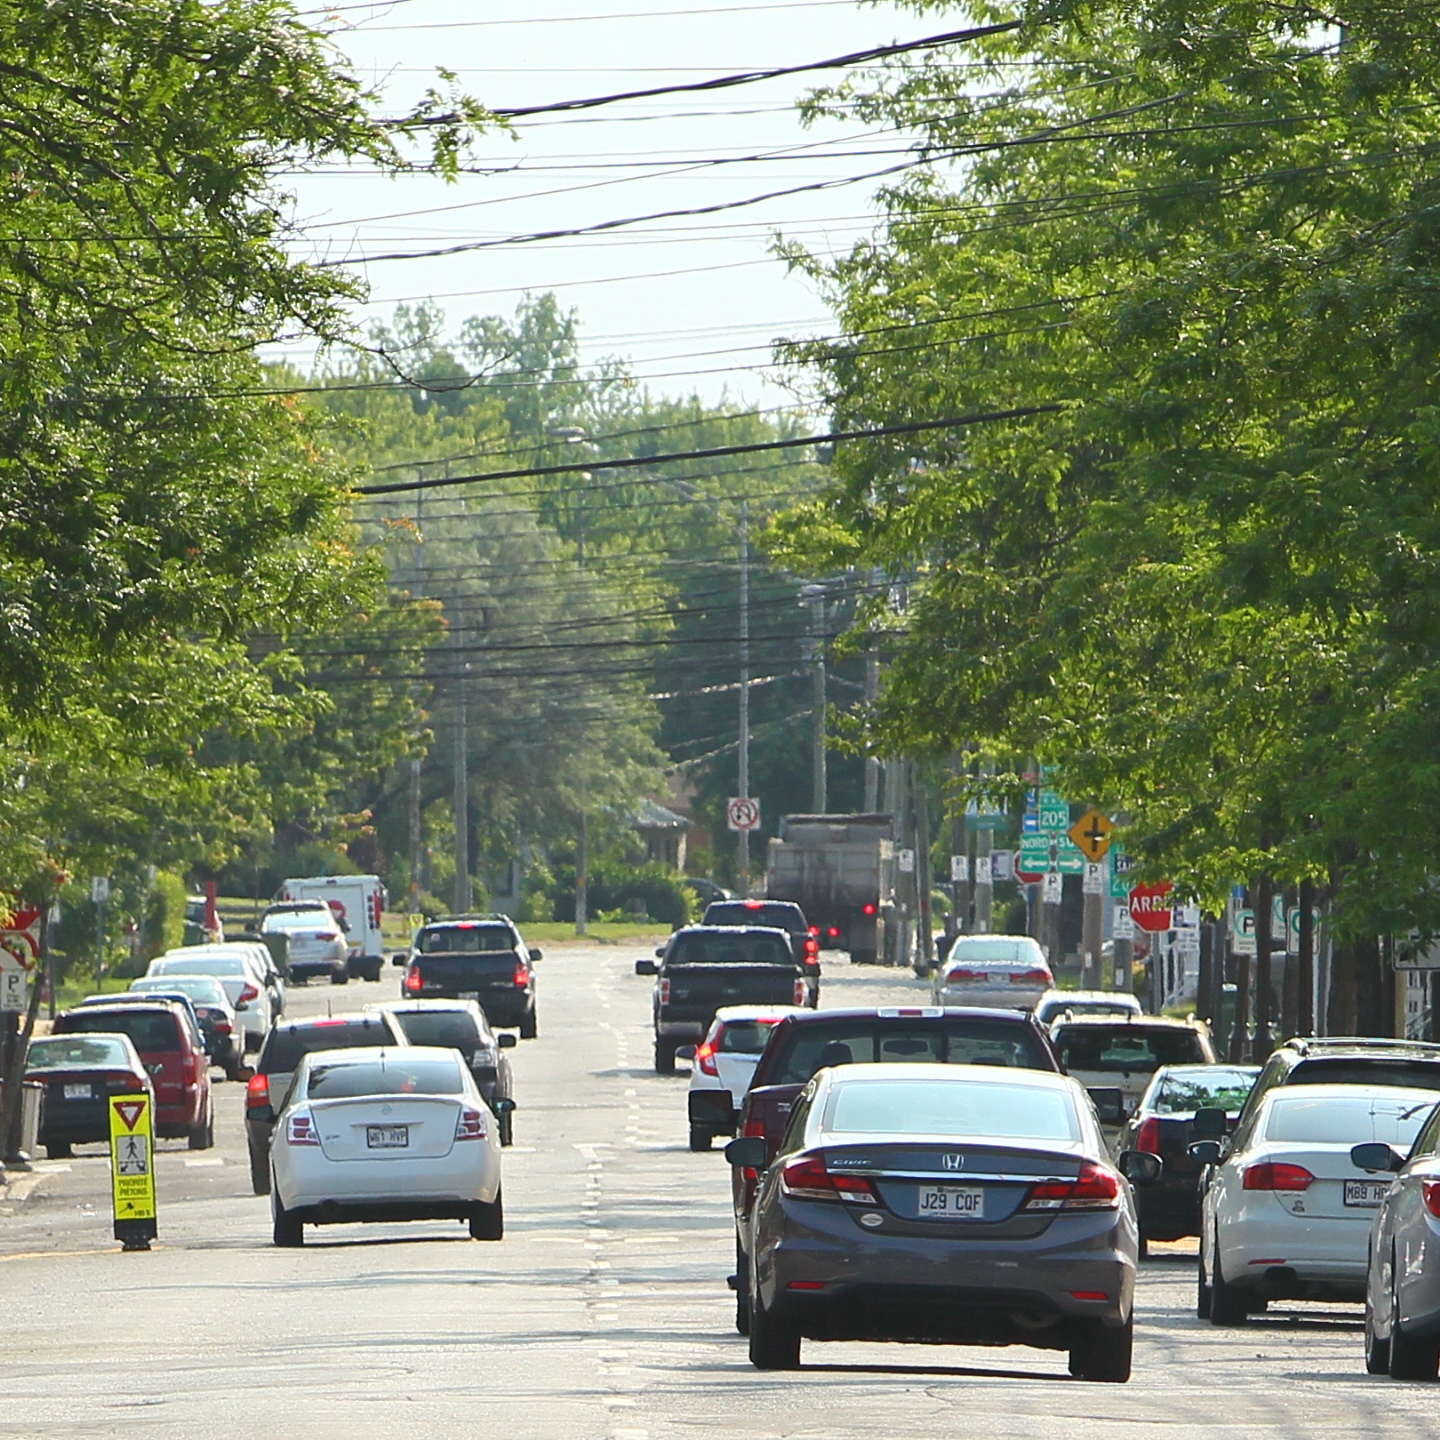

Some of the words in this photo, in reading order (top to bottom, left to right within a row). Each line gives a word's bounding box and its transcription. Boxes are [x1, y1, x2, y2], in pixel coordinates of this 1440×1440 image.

[1041, 811, 1067, 826] 205
[1021, 837, 1048, 849] NORD
[921, 1194, 947, 1210] J29
[955, 1194, 982, 1210] CQF
